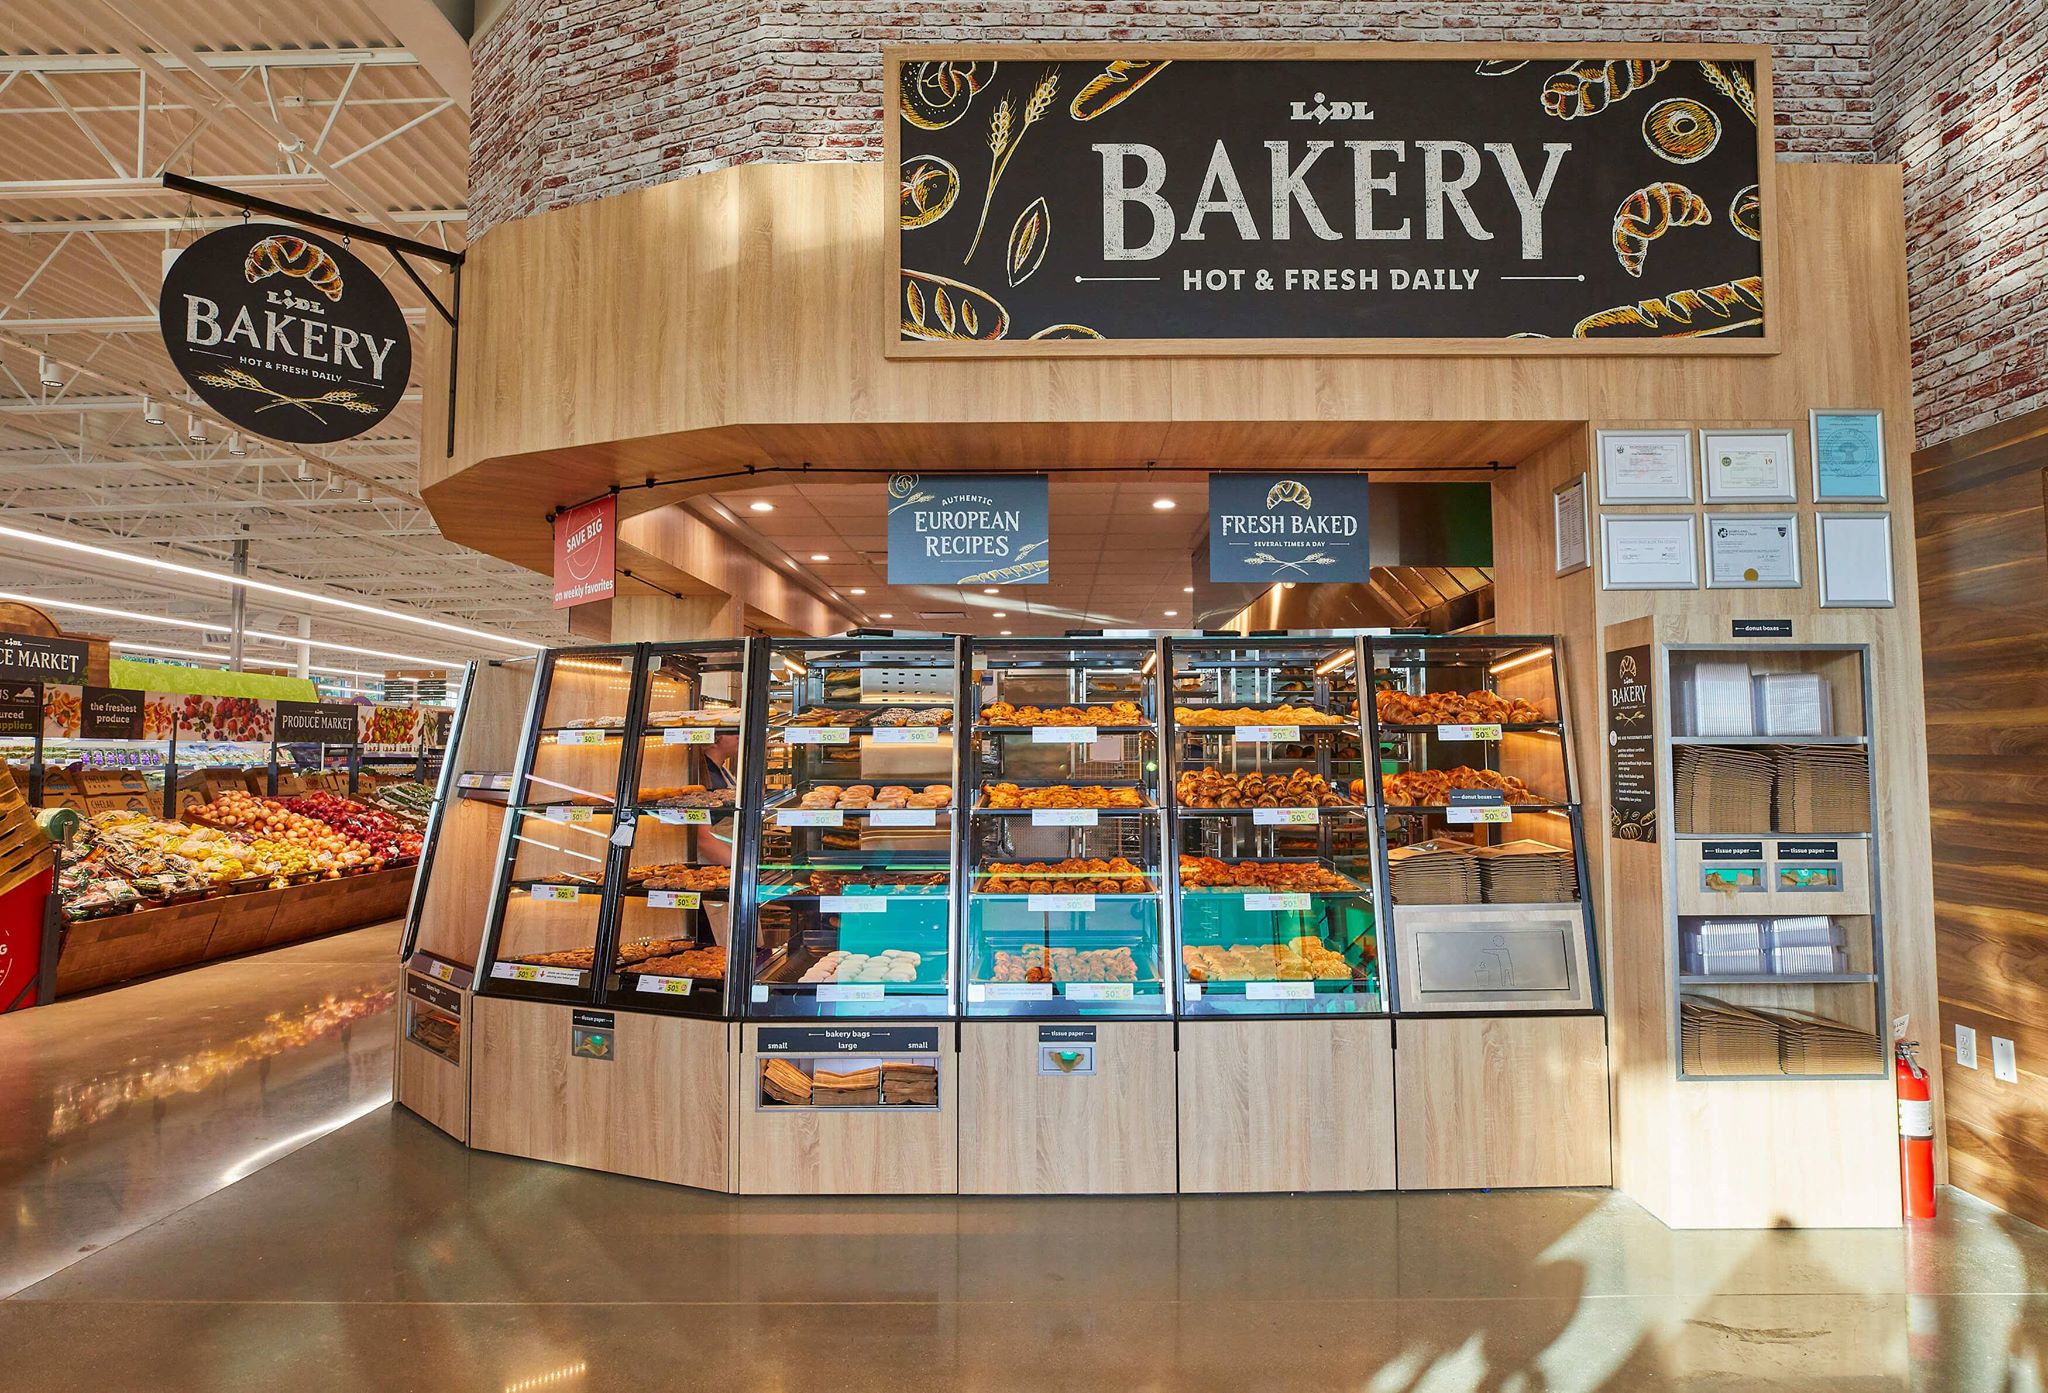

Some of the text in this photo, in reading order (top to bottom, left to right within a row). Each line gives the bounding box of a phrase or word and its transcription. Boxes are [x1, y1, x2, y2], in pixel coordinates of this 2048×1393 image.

[1091, 139, 1573, 261] BAKERY
[1183, 269, 1480, 291] HOT & FRESH DAILY
[183, 293, 396, 381] BAKERY
[239, 356, 342, 383] HOT & FRESH DAILY
[941, 494, 993, 506] AUTHENTIC
[915, 510, 1021, 533] EUROPEAN
[1220, 514, 1358, 537] FRESH BAKED
[566, 518, 603, 553] SAVE BIG
[925, 535, 1010, 557] RECIPES
[555, 579, 614, 602] on weekly favorites
[18, 650, 80, 673] MARKET
[1611, 685, 1647, 707] BAKERY
[90, 702, 137, 713] the freshest
[96, 714, 130, 725] produce
[282, 715, 353, 731] PRODUCE MARKET
[767, 1041, 788, 1049] small
[825, 1030, 870, 1038] bakery bags
[907, 1041, 928, 1049] small
[838, 1042, 857, 1050] large
